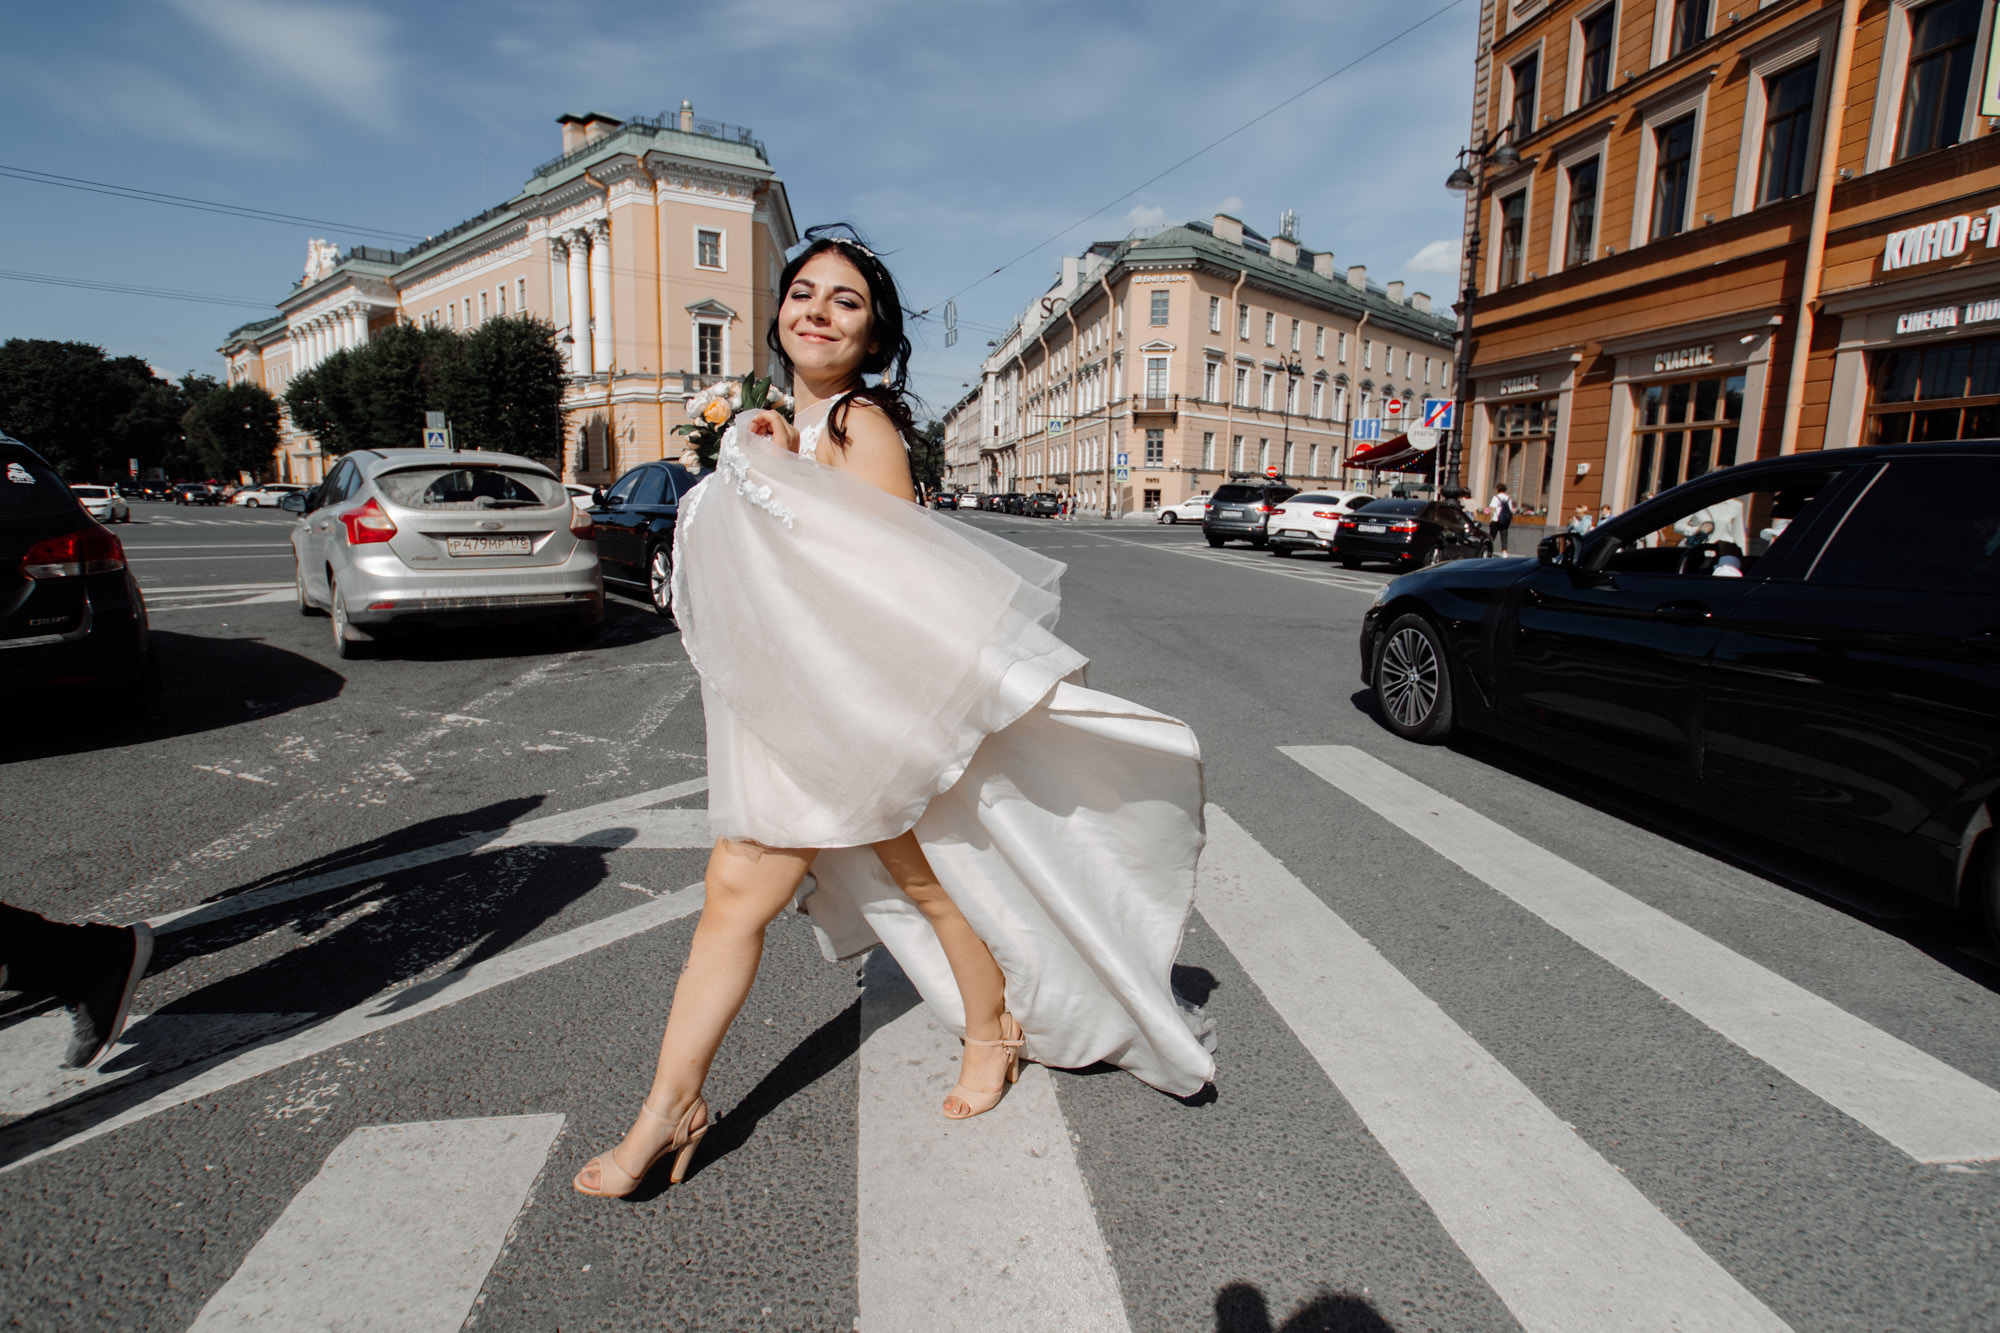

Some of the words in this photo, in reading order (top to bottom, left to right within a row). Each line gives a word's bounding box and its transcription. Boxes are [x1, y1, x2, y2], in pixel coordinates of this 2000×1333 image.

[1896, 306, 1959, 334] CINEMA
[1964, 299, 2000, 324] LOU
[1654, 345, 1714, 372] СЧАСТЬЕ
